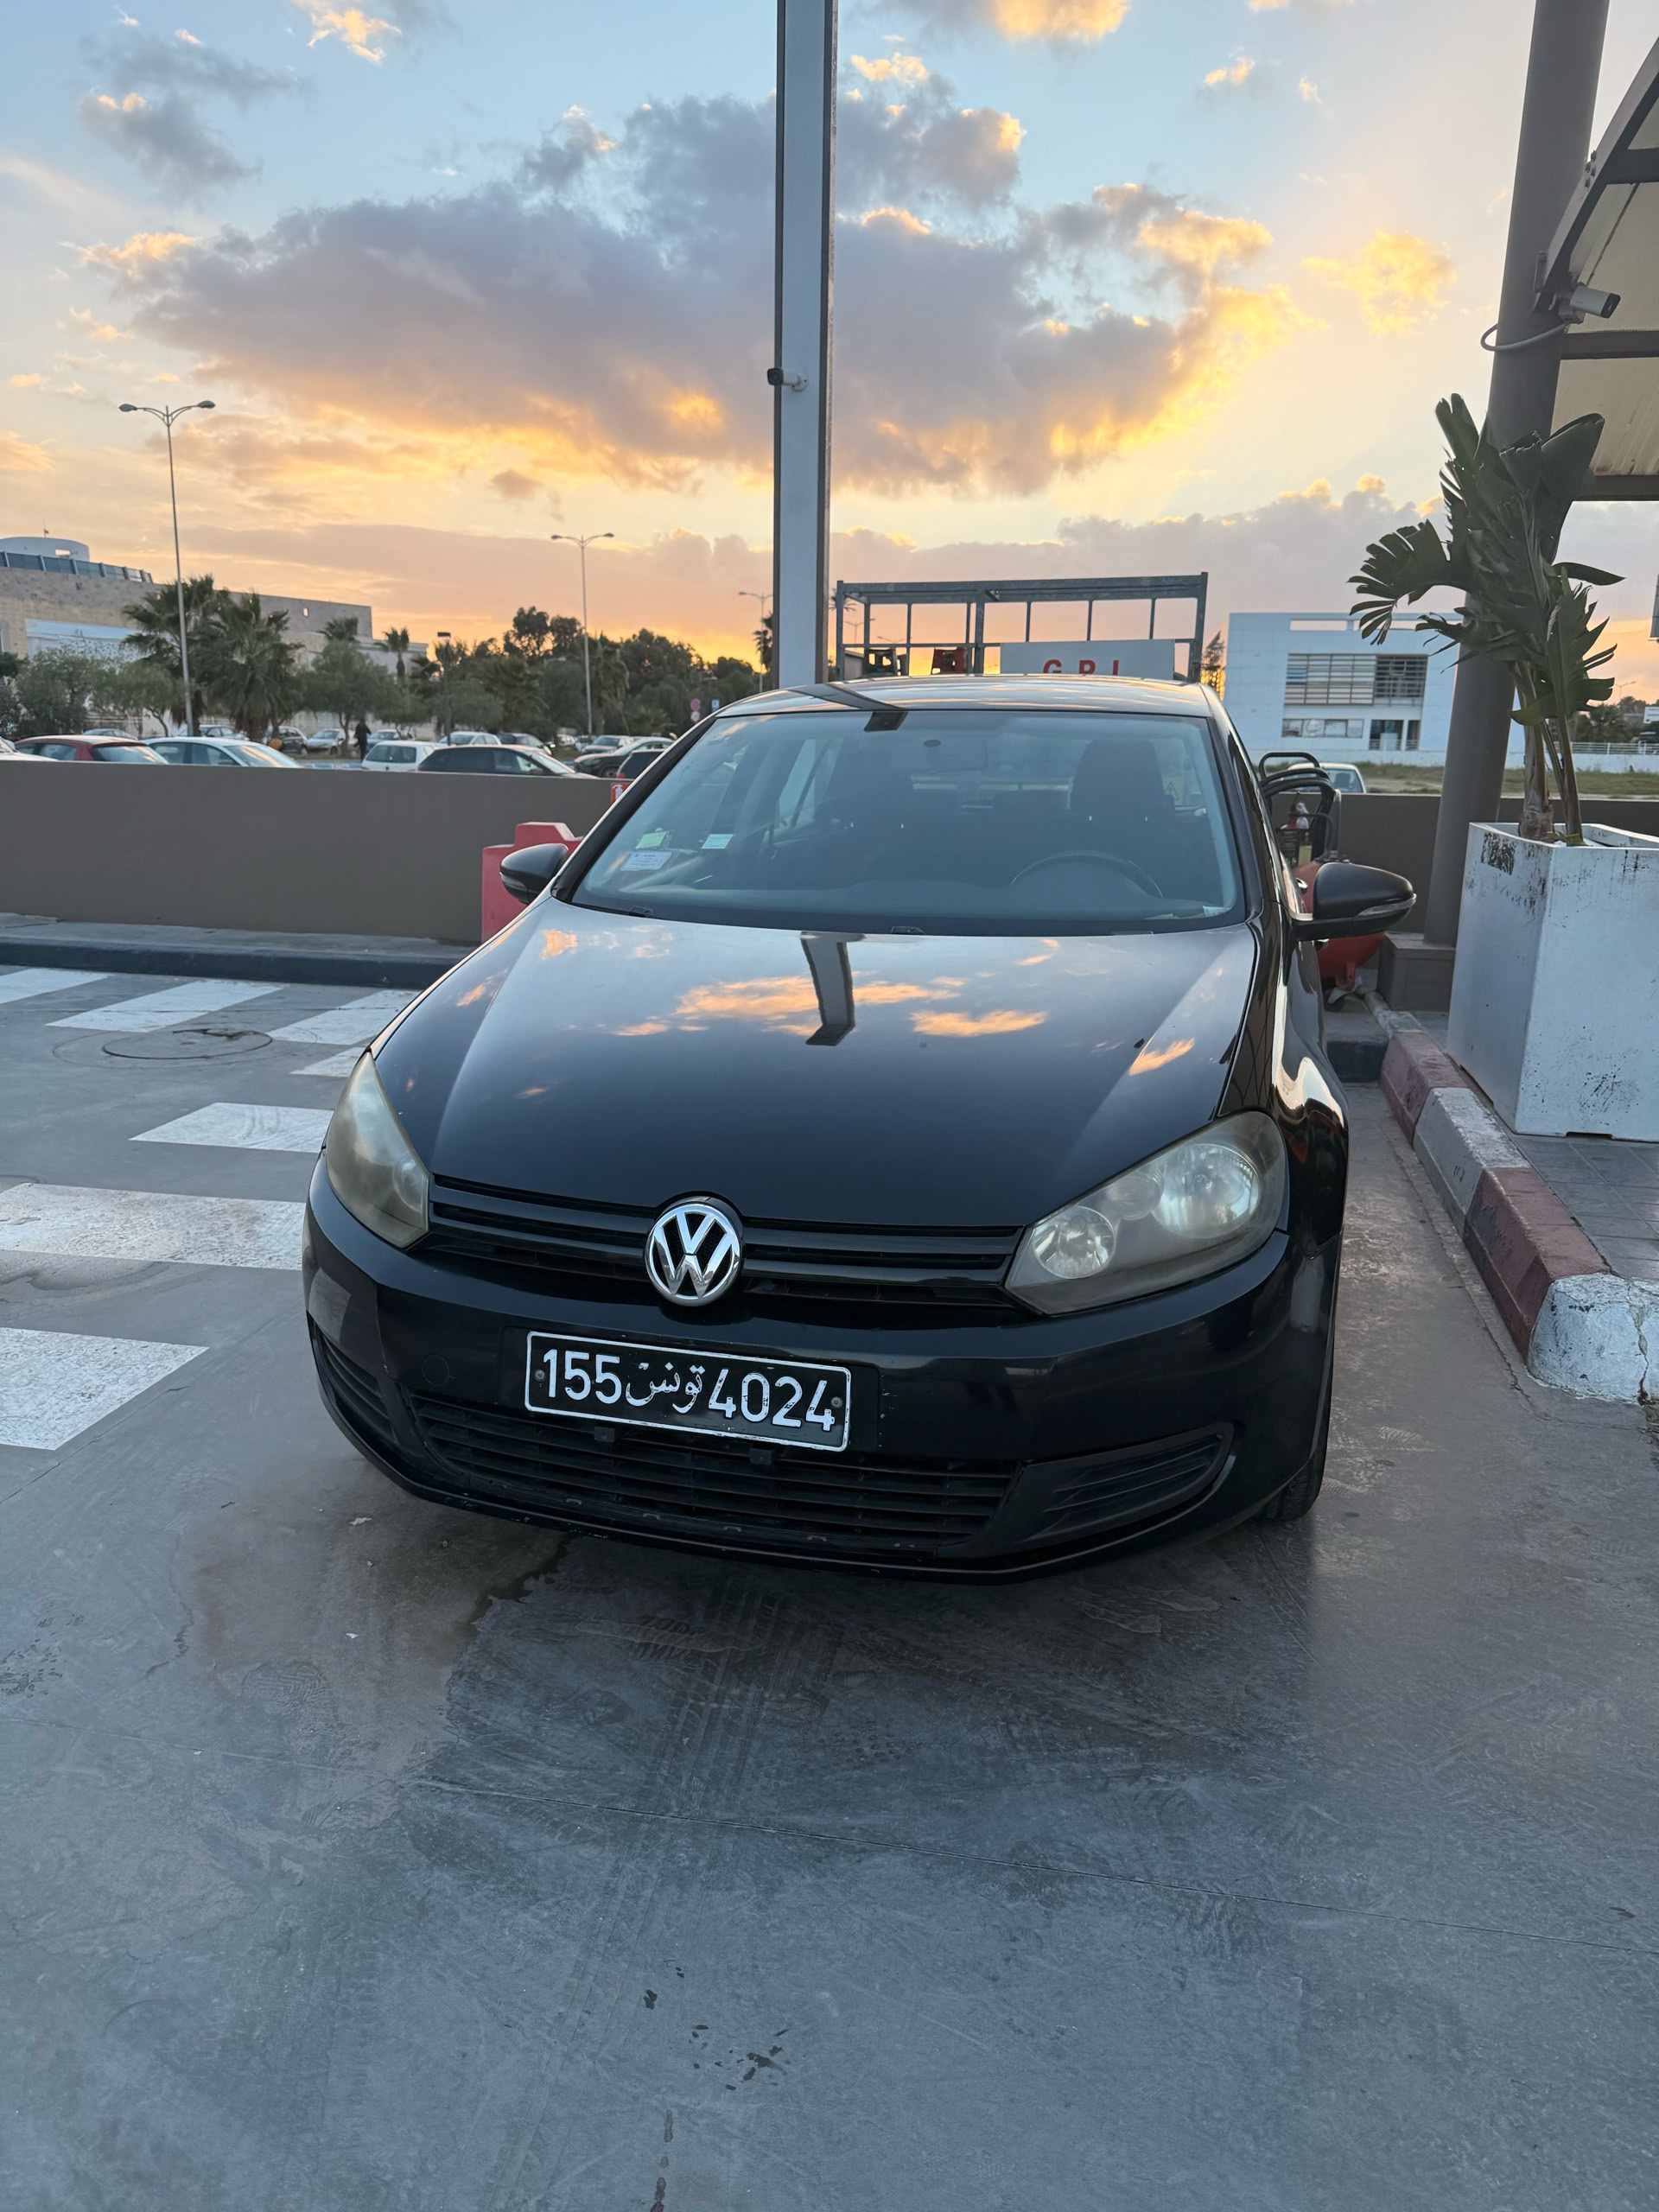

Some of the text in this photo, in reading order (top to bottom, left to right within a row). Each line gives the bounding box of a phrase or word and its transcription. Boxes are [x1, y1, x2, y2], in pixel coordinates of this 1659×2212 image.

[543, 1349, 836, 1432] 155 تونس 4024
